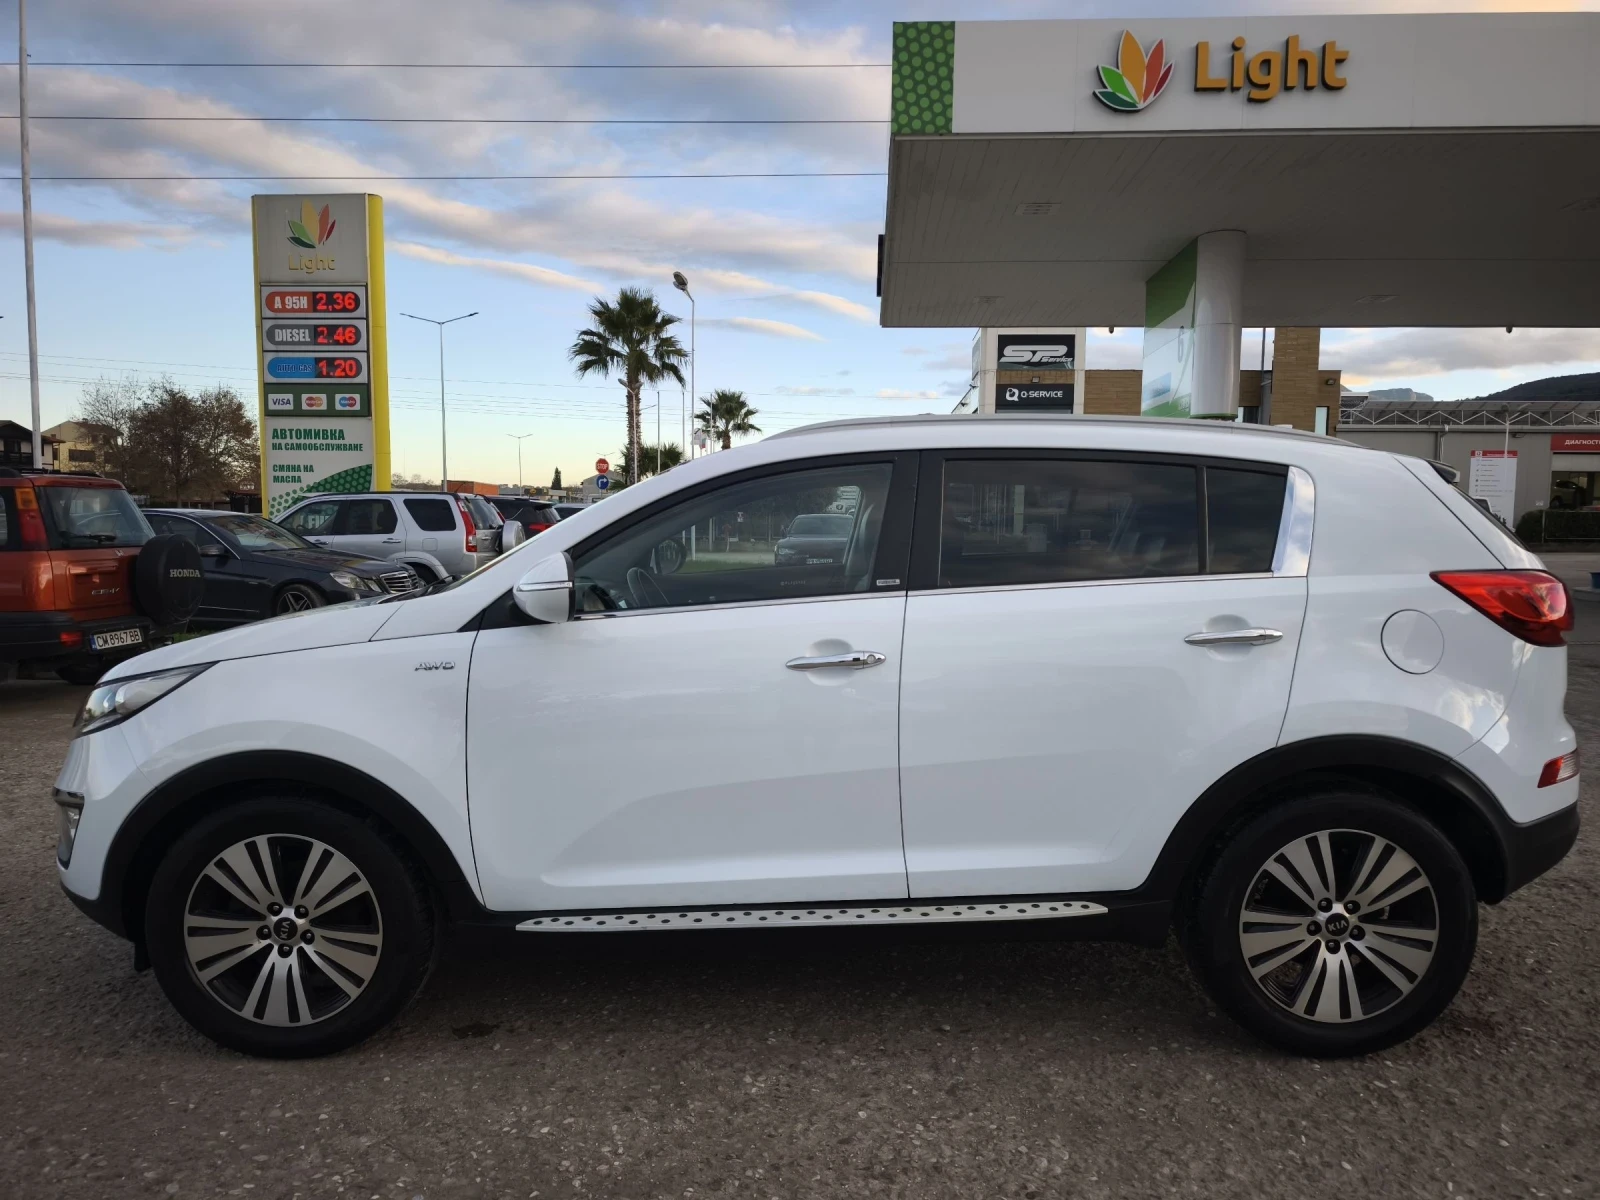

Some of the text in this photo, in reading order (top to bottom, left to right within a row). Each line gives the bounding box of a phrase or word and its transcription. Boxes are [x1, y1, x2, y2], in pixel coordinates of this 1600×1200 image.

[1194, 34, 1349, 102] Light
[288, 253, 336, 274] Light
[316, 292, 356, 311] 2.36
[275, 329, 310, 342] DIESEL
[317, 326, 356, 344] 2.46
[999, 344, 1068, 363] SP
[317, 359, 357, 377] 1.20
[272, 398, 292, 406] VISA
[272, 428, 345, 440] АВТОМИВКА
[271, 442, 364, 452] НА САМООБСЛУЖВАНЕ
[272, 464, 315, 473] СМЯНА НА
[272, 475, 302, 484] МАСЛА
[169, 568, 201, 578] HONDA
[96, 630, 140, 648] CM 8967 BB
[414, 661, 455, 671] AWD
[280, 921, 290, 938] KIA
[1328, 920, 1348, 931] KIA
